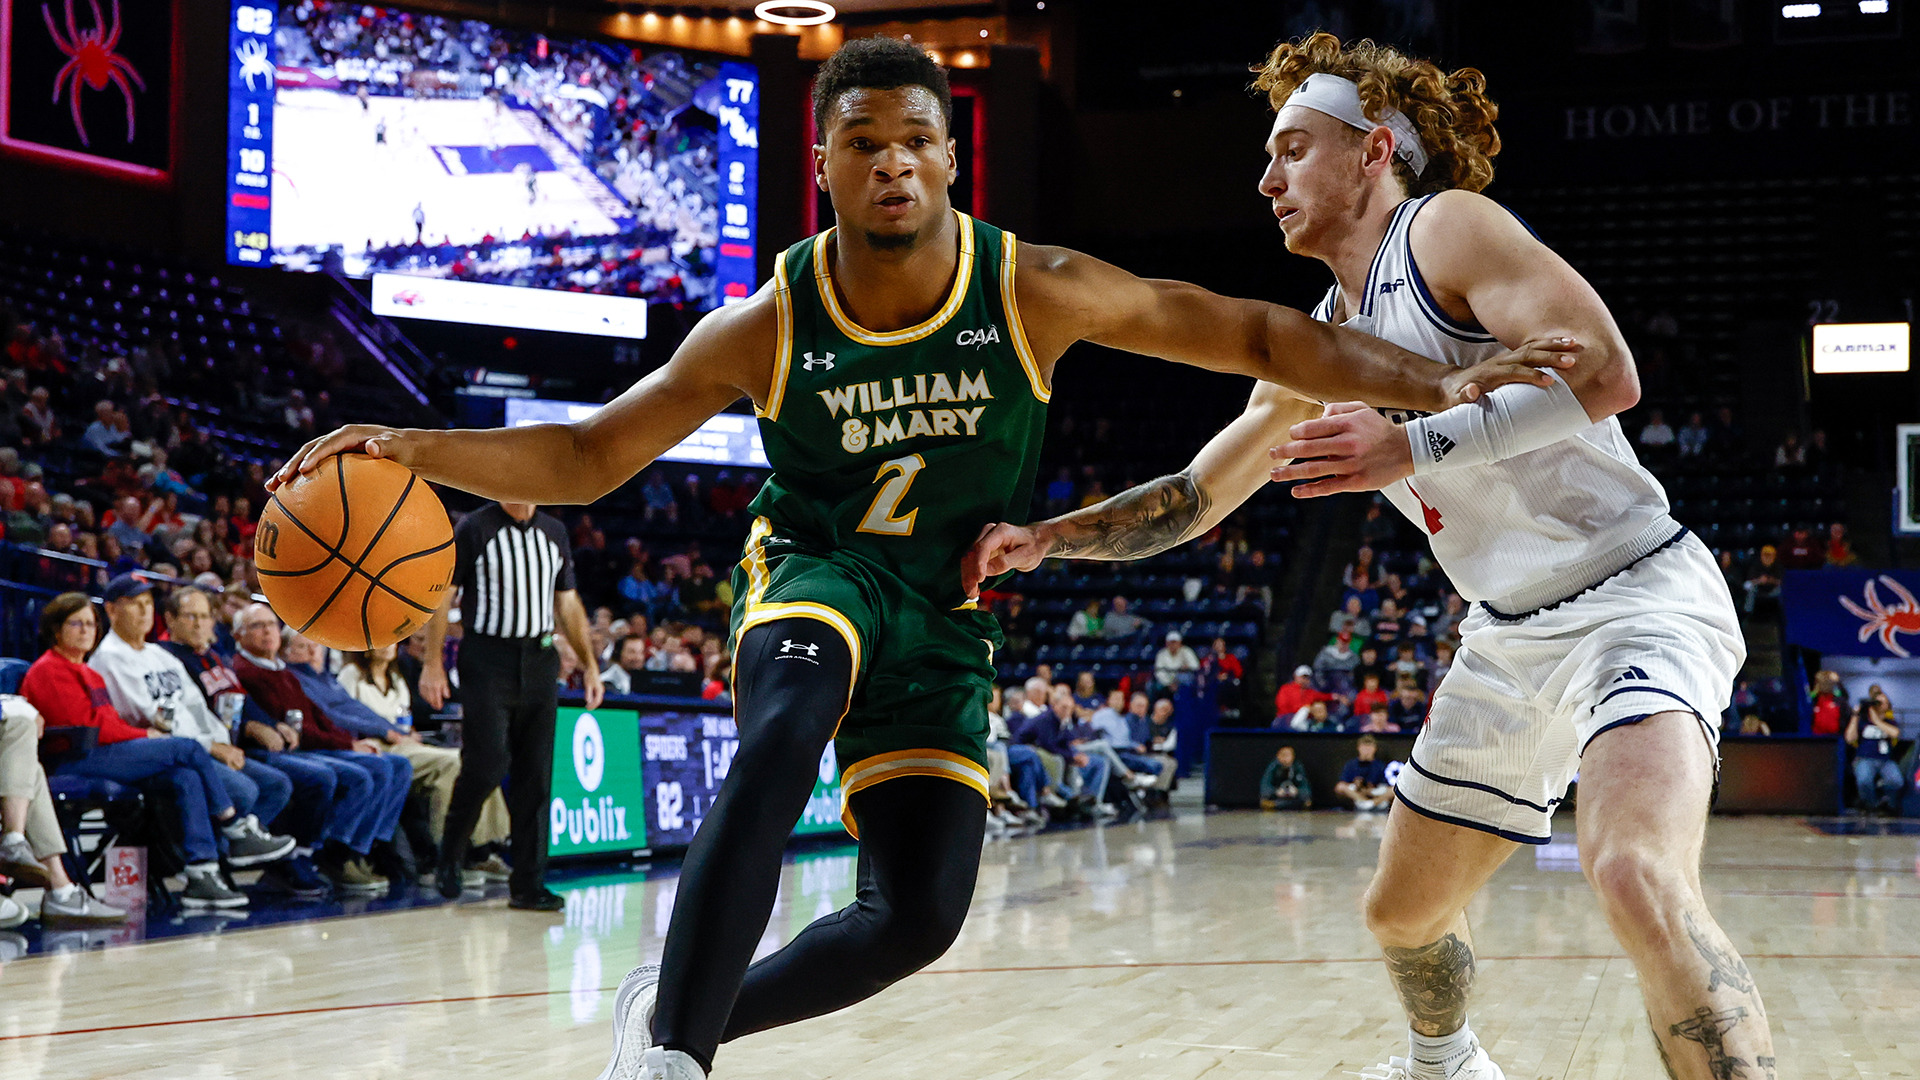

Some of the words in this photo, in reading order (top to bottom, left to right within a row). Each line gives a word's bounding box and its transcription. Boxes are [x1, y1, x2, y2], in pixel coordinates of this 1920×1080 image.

[236, 5, 273, 36] 82
[726, 78, 754, 104] 77
[247, 102, 259, 126] 1
[1564, 101, 1711, 140] HOME
[1728, 97, 1793, 132] OF
[1808, 91, 1912, 128] THE
[239, 147, 265, 173] 10
[956, 324, 1001, 350] CAA
[816, 368, 995, 420] WILLIAM
[841, 418, 870, 453] &
[871, 405, 987, 448] MARY
[1427, 430, 1443, 463] adidas
[855, 453, 926, 537] 2
[645, 734, 688, 761] SPIDERS
[550, 795, 632, 845] Publix
[656, 781, 685, 831] 82
